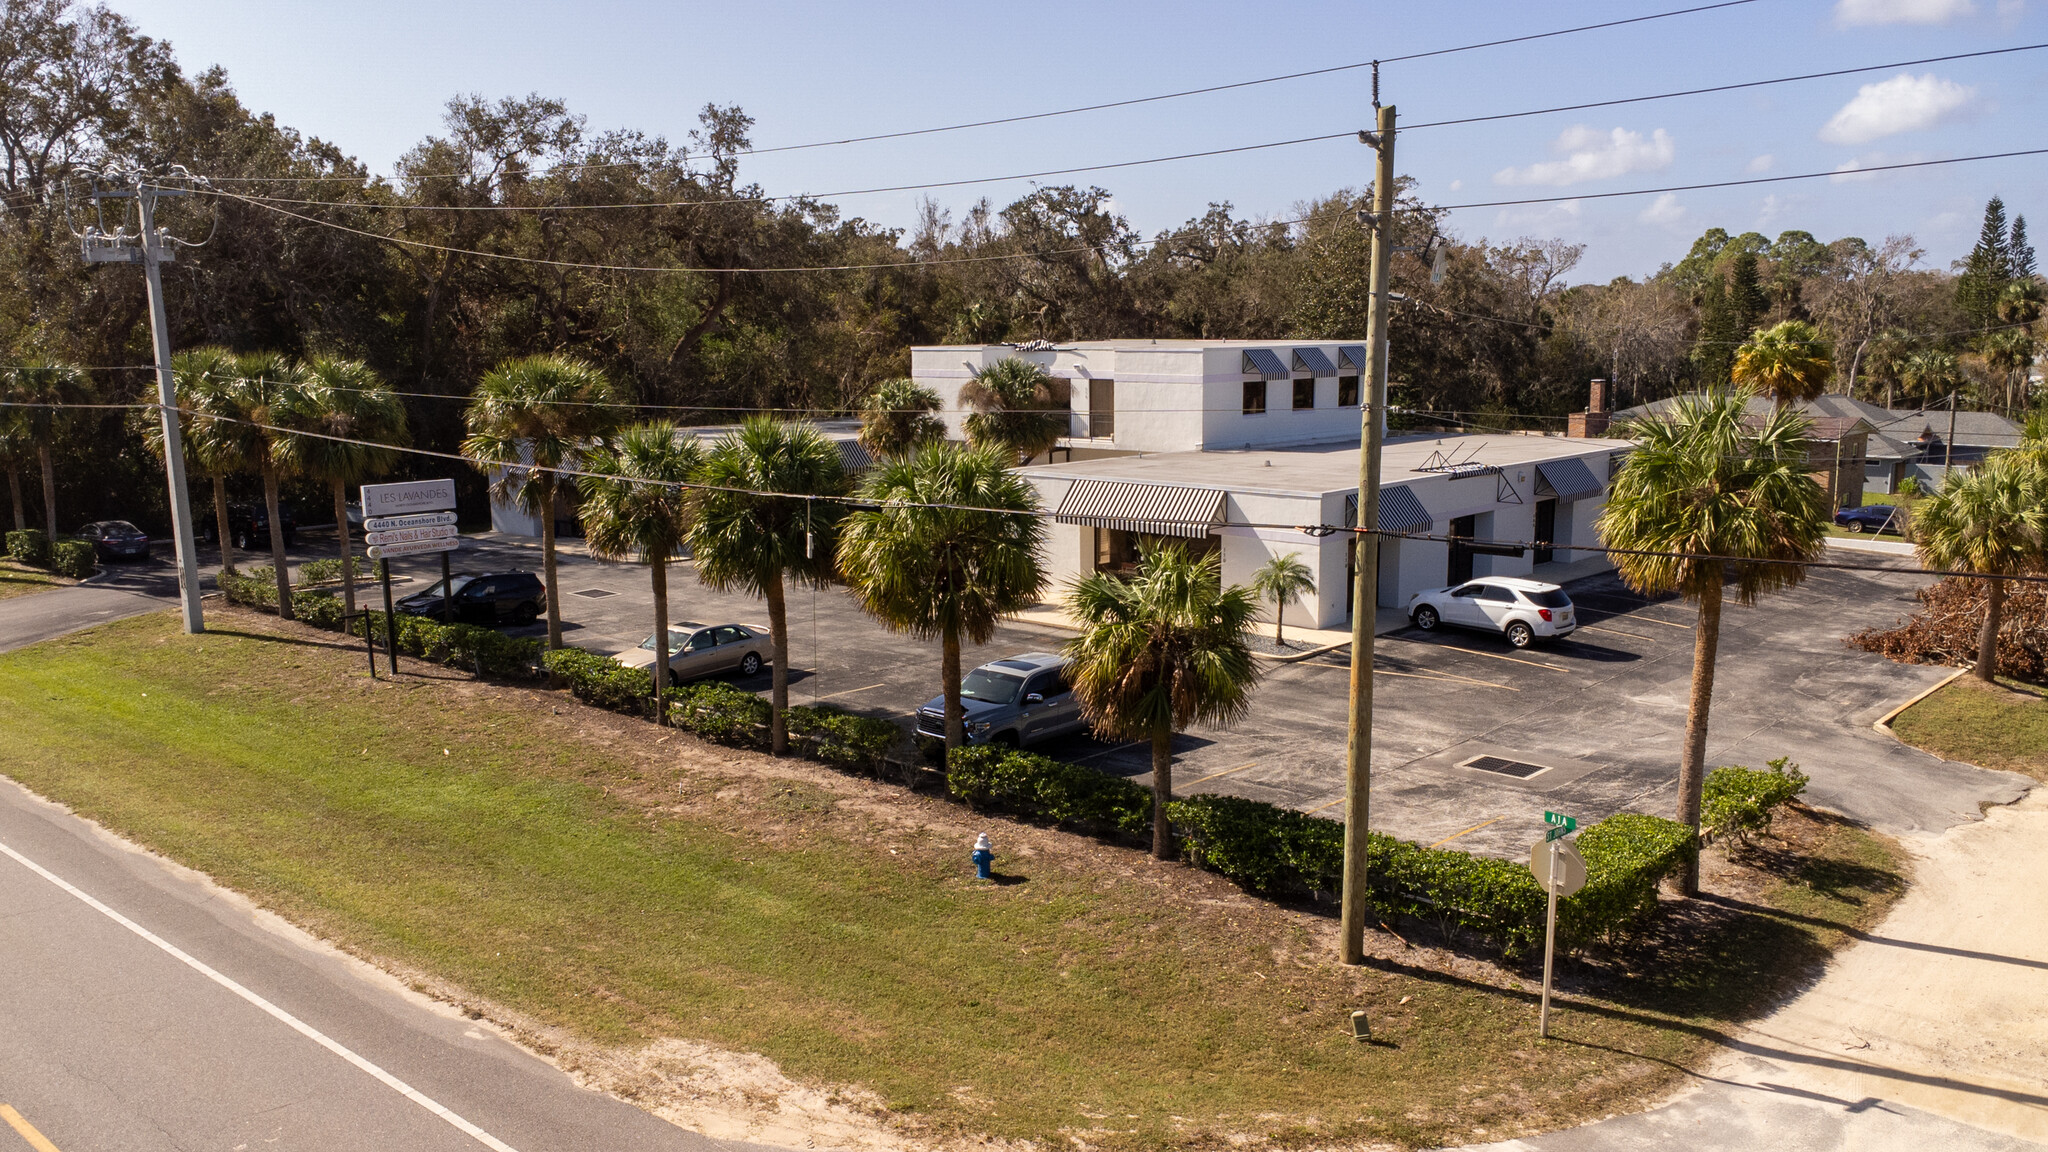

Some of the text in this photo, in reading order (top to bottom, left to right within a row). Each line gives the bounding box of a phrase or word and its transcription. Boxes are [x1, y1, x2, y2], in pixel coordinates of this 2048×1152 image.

[380, 489, 448, 503] LES LAVANDES
[399, 518, 435, 526] Oceanshore
[380, 527, 448, 543] Remi's Nails & Hair Studio
[403, 544, 431, 552] AYURVEDA
[1551, 814, 1567, 826] A1A
[1547, 832, 1552, 842] ST
